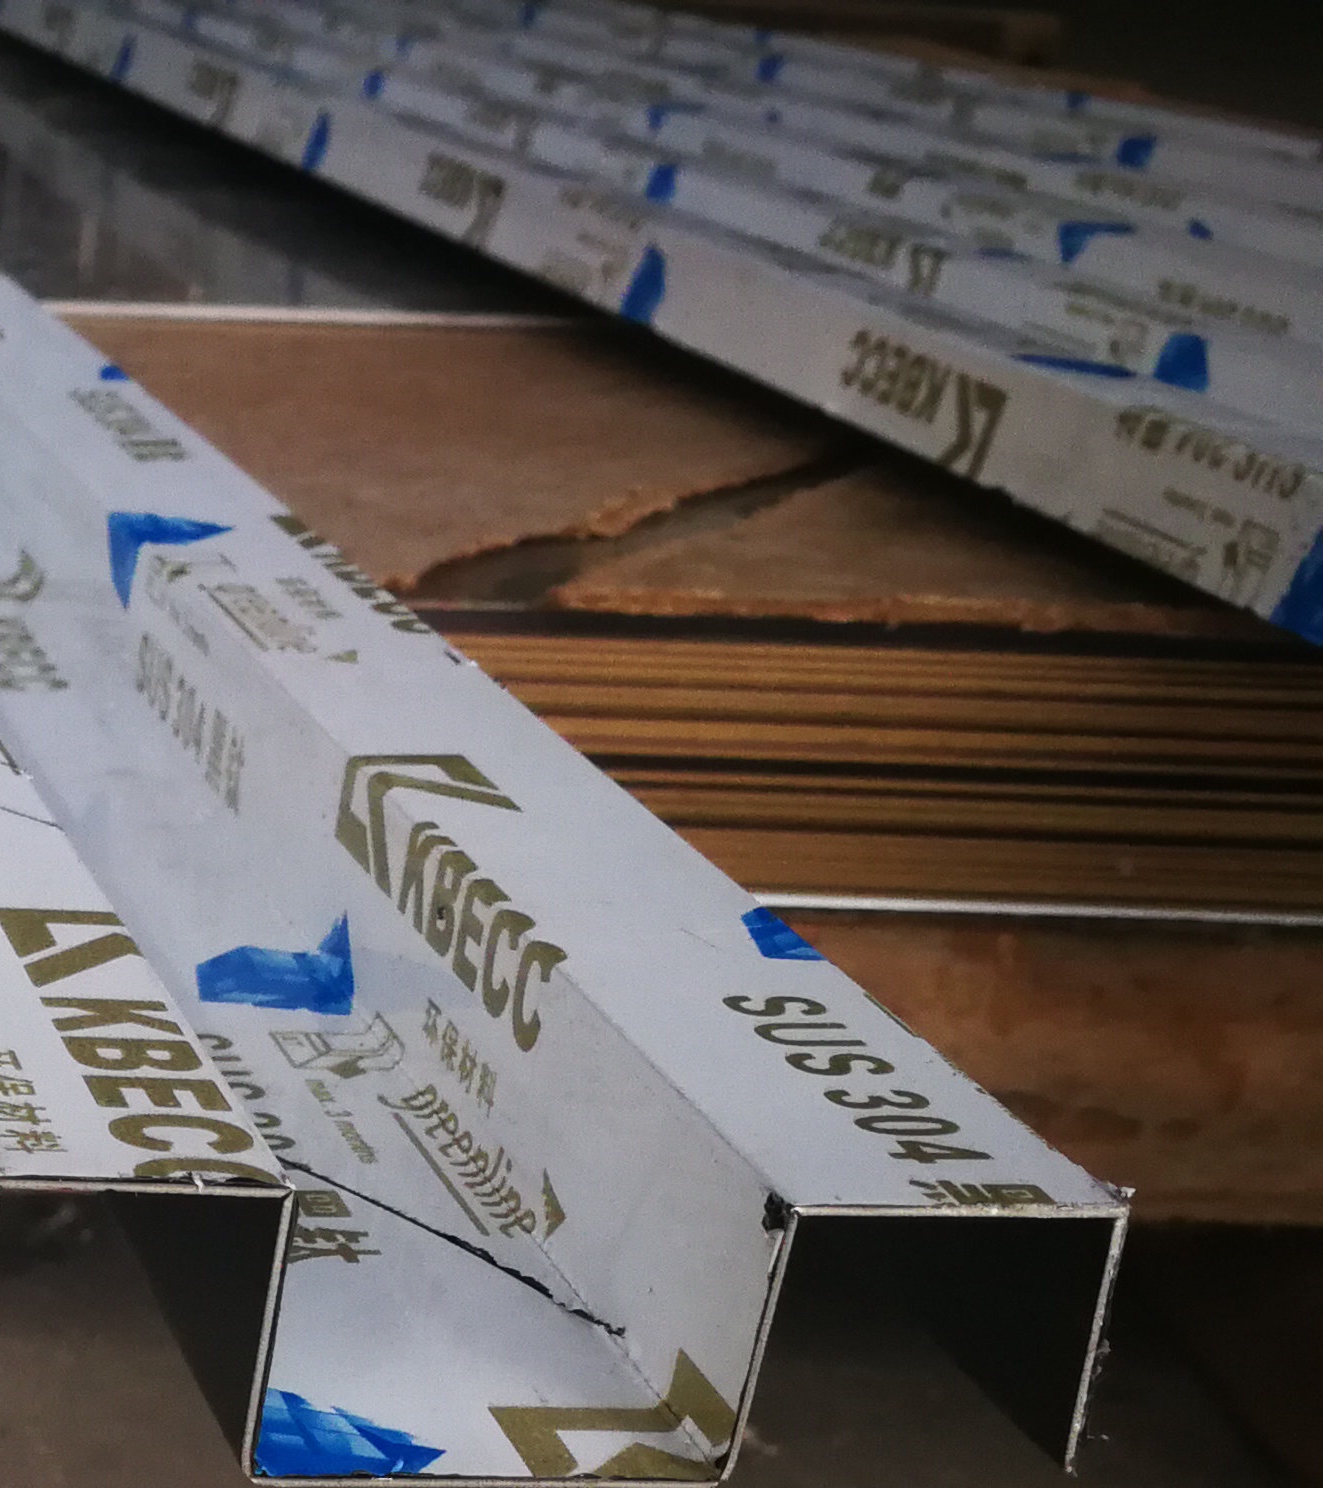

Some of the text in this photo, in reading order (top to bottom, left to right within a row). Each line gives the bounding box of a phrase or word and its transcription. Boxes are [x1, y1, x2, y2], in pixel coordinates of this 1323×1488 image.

[398, 821, 569, 1054] KBECC
[722, 995, 896, 1076] SUS
[824, 1089, 996, 1164] 304
